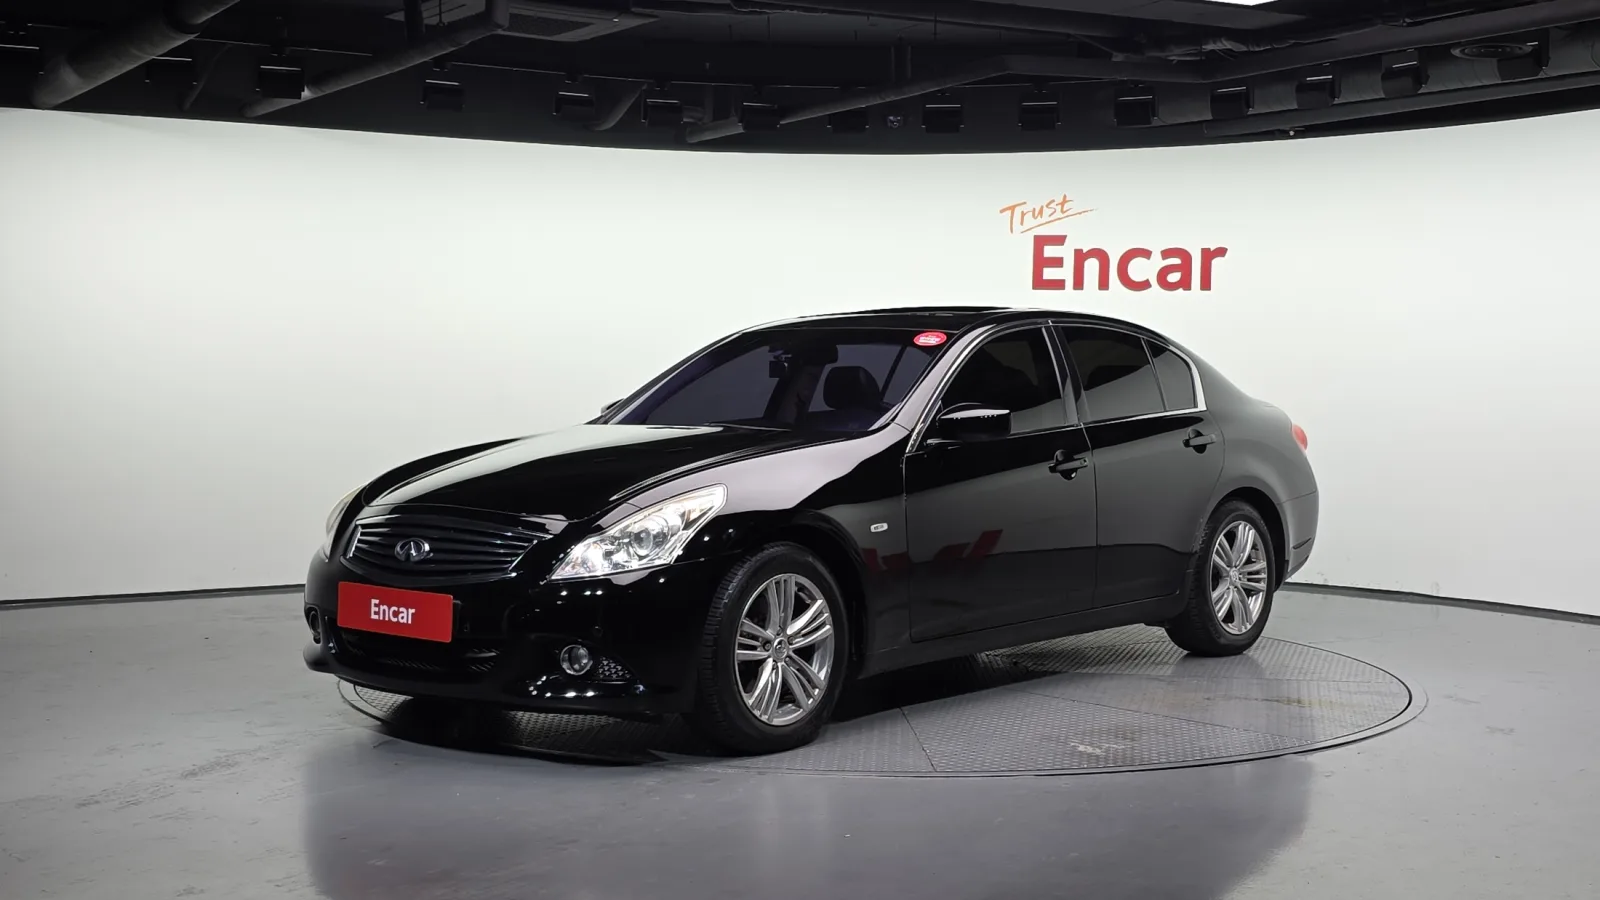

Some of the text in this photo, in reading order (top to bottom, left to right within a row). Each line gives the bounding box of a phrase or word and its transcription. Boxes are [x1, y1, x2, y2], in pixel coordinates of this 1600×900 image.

[999, 193, 1074, 234] Trust
[1032, 234, 1228, 291] Encar
[370, 598, 416, 624] Encar
